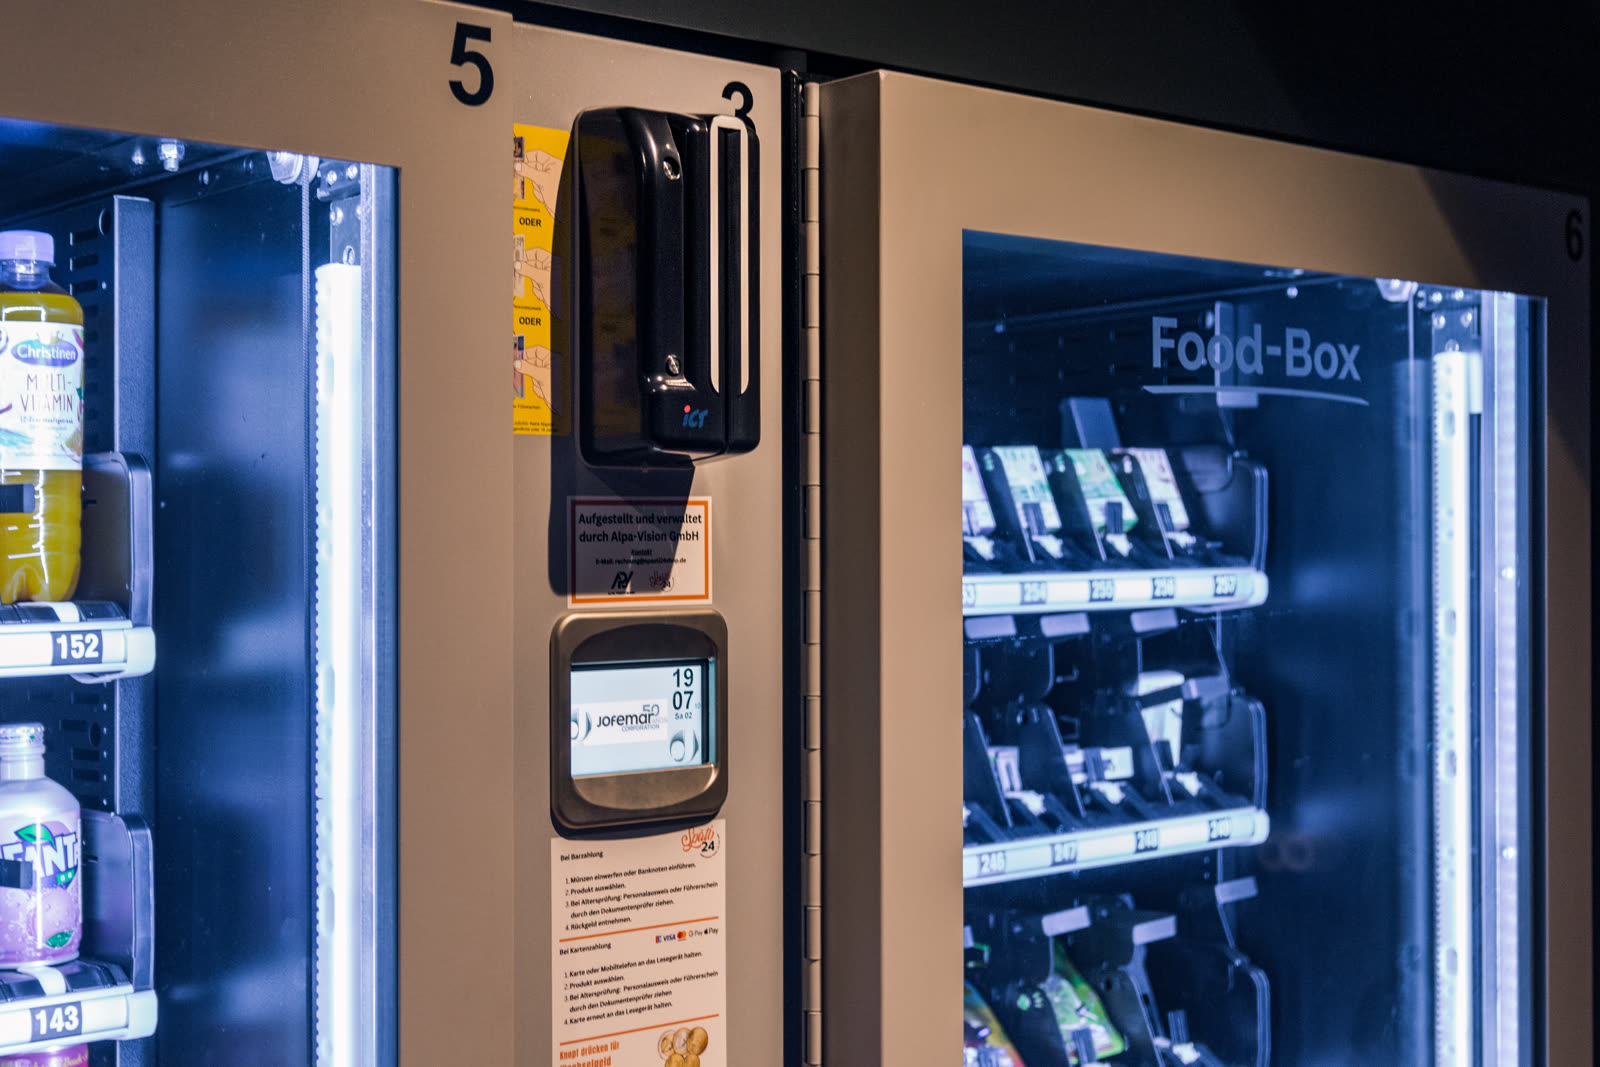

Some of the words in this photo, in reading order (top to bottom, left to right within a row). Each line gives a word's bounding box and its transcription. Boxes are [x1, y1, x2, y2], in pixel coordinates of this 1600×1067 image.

[448, 21, 495, 107] 5
[519, 217, 542, 227] ODER
[1565, 207, 1584, 262] 6
[519, 316, 542, 326] ODER
[16, 343, 77, 361] Christinen
[1152, 316, 1361, 382] Food-Box
[578, 513, 634, 527] Aufgestellt
[636, 513, 655, 524] und
[656, 513, 702, 524] verwaltet
[579, 531, 609, 543] durch
[611, 531, 667, 544] Alpa-Vision
[669, 531, 699, 542] GmbH
[56, 633, 99, 660] 152
[673, 668, 694, 688] 19
[673, 691, 694, 710] 07
[621, 724, 660, 732] CORPORATION
[701, 840, 715, 852] 24
[560, 853, 570, 862] Bei
[571, 850, 604, 860] Barzahlung
[570, 874, 594, 884] Münzen
[594, 871, 623, 881] einwerfen
[623, 869, 637, 877] oder
[637, 866, 668, 875] Banknoten
[668, 862, 696, 871] einführen.
[570, 886, 594, 895] Produkt
[594, 883, 626, 892] auswählen.
[571, 899, 581, 907] Bei
[623, 888, 669, 900] Personalausweis
[669, 886, 682, 894] oder
[683, 881, 718, 892] Führerschein
[571, 910, 588, 919] durch
[588, 908, 600, 916] den
[600, 902, 654, 915] Dokumentenprüfer
[655, 899, 675, 907] ziehen.
[570, 921, 597, 931] Rückgeld
[598, 916, 632, 927] entnehmen.
[709, 927, 719, 935] Pay
[570, 942, 612, 954] Kartenzahlung
[569, 970, 585, 978] Karte
[586, 967, 599, 975] oder
[600, 962, 637, 973] Mobiltelefon
[646, 957, 656, 965] das
[656, 953, 683, 965] Lesegerät
[684, 951, 703, 959] halten.
[569, 980, 593, 989] Produkt
[593, 975, 625, 985] auswählen.
[623, 979, 669, 992] Personalausweis
[669, 975, 682, 984] oder
[683, 970, 719, 982] Führerschein
[569, 1004, 587, 1013] durch
[599, 995, 653, 1008] Dokumentenprüfer
[654, 989, 673, 998] ziehen
[35, 1005, 80, 1035] 143
[569, 1016, 585, 1024] Karte
[586, 1013, 606, 1021] erneut
[614, 1008, 625, 1016] das
[625, 1005, 653, 1016] Lesegerät
[654, 1001, 673, 1009] halten.
[559, 1049, 579, 1061] Knopf
[580, 1044, 609, 1057] drücken
[610, 1041, 620, 1050] für
